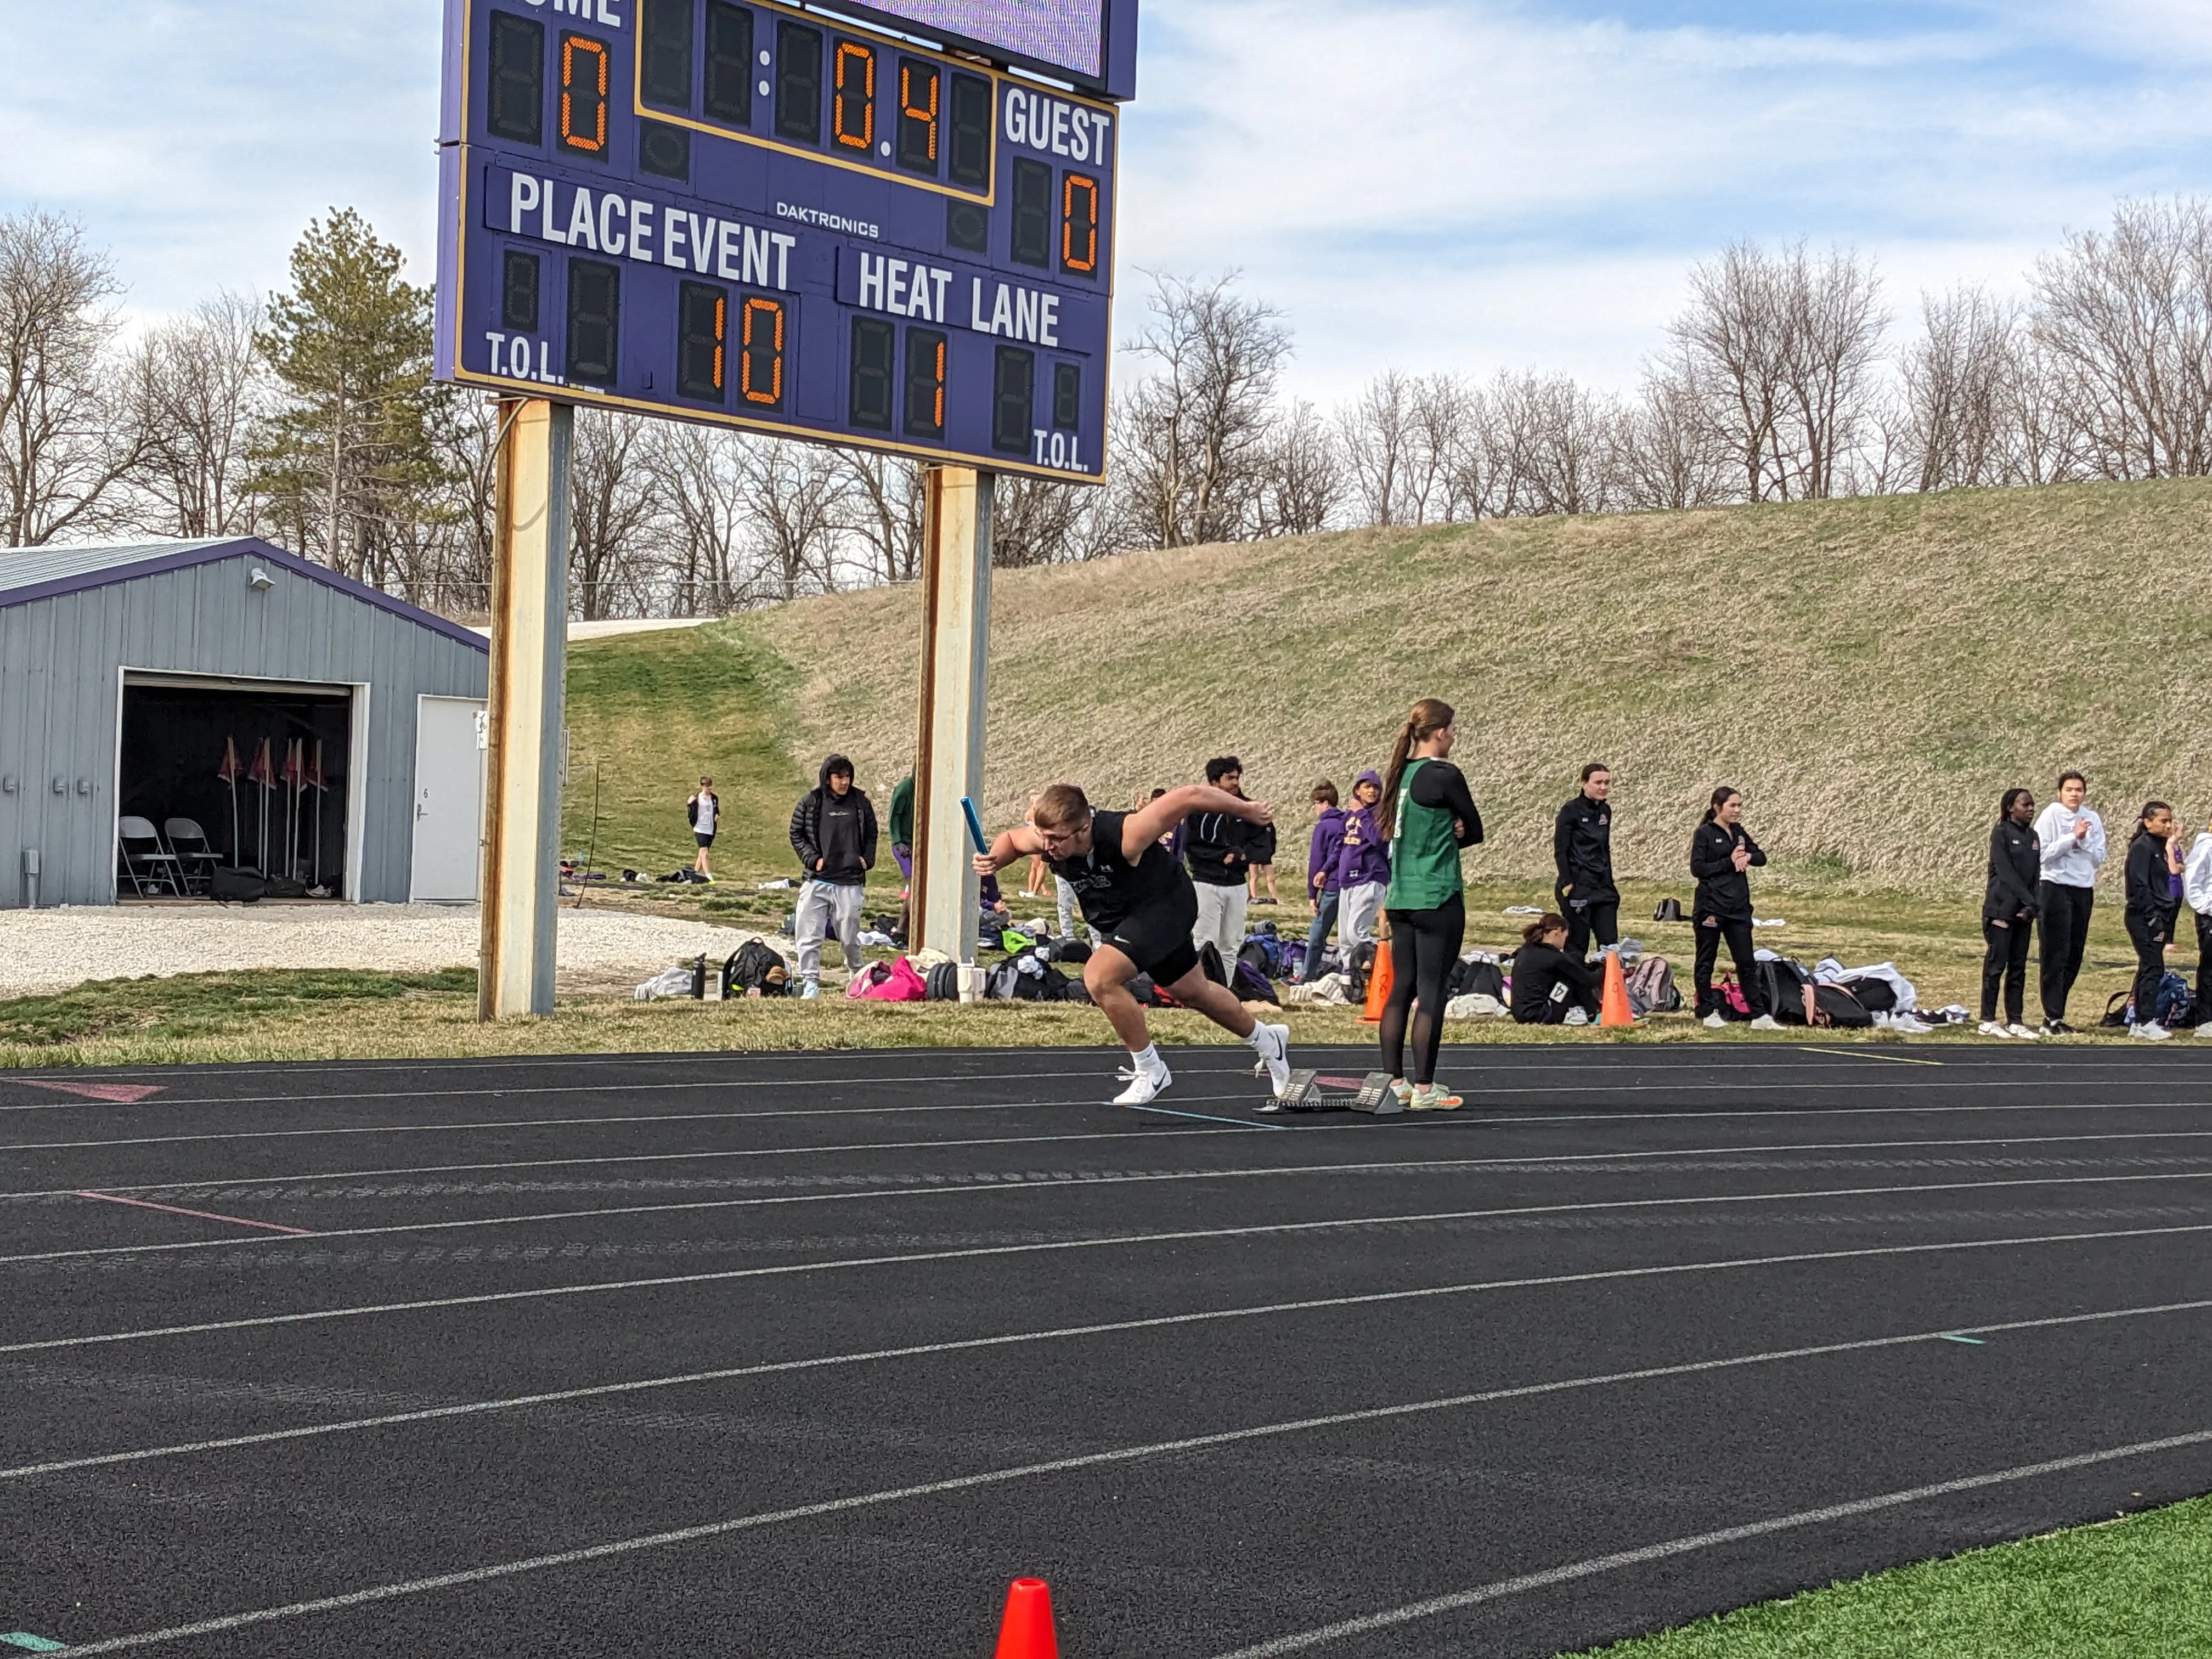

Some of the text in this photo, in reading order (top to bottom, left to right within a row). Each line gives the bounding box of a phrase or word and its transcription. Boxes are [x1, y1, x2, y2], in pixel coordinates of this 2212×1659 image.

[562, 36, 606, 151] 0
[1006, 88, 1109, 165] GUEST
[511, 172, 795, 291] PLACE EVENT
[777, 201, 879, 239] DAKTRONICS
[1063, 175, 1097, 271] 0
[859, 252, 1059, 347] HEAT LANE
[486, 332, 564, 384] T.O.L.
[713, 297, 783, 404] 10
[935, 341, 945, 428] 1
[1034, 429, 1088, 472] T.O.L.
[424, 788, 428, 798] 6
[1379, 974, 1388, 998] 8
[1554, 985, 1565, 997] 4
